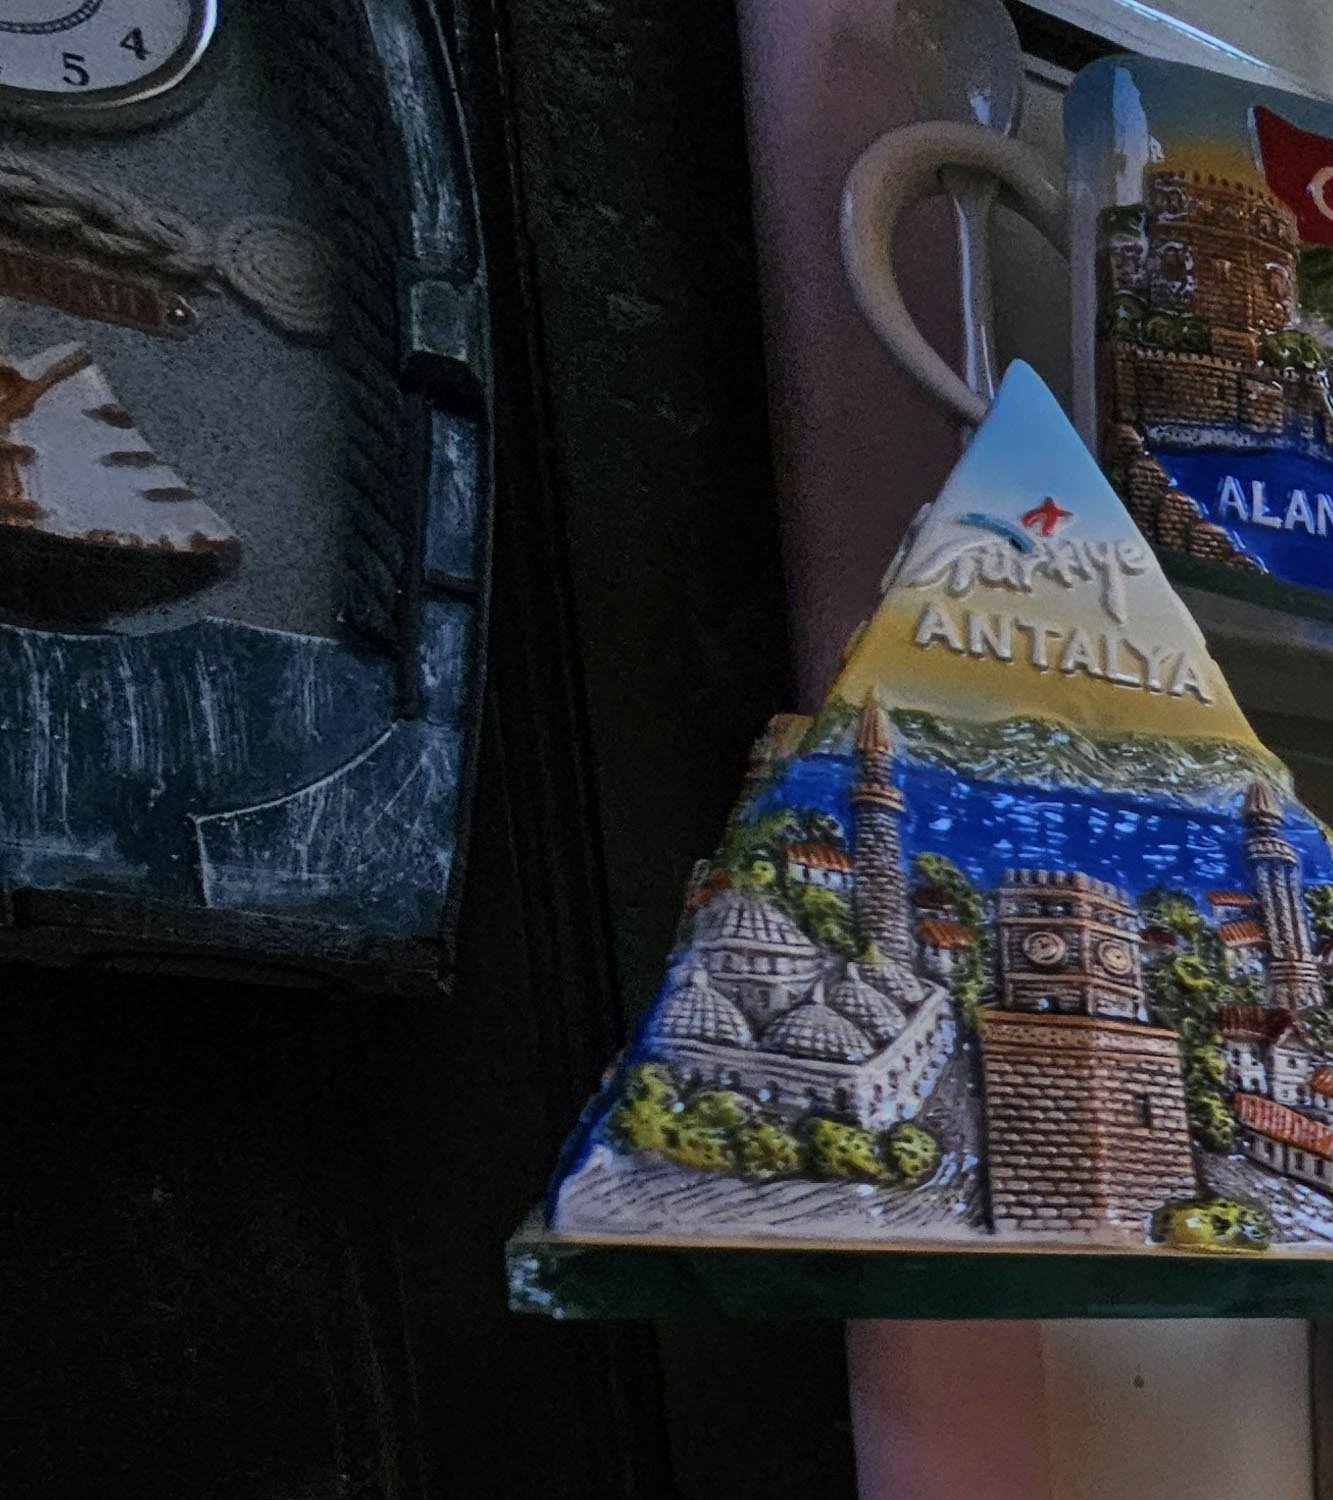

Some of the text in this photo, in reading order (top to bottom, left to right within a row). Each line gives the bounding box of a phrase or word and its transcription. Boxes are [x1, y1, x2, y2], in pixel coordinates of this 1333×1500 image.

[119, 28, 151, 61] 4
[61, 53, 89, 86] 5
[912, 601, 1213, 706] ANTALYA
